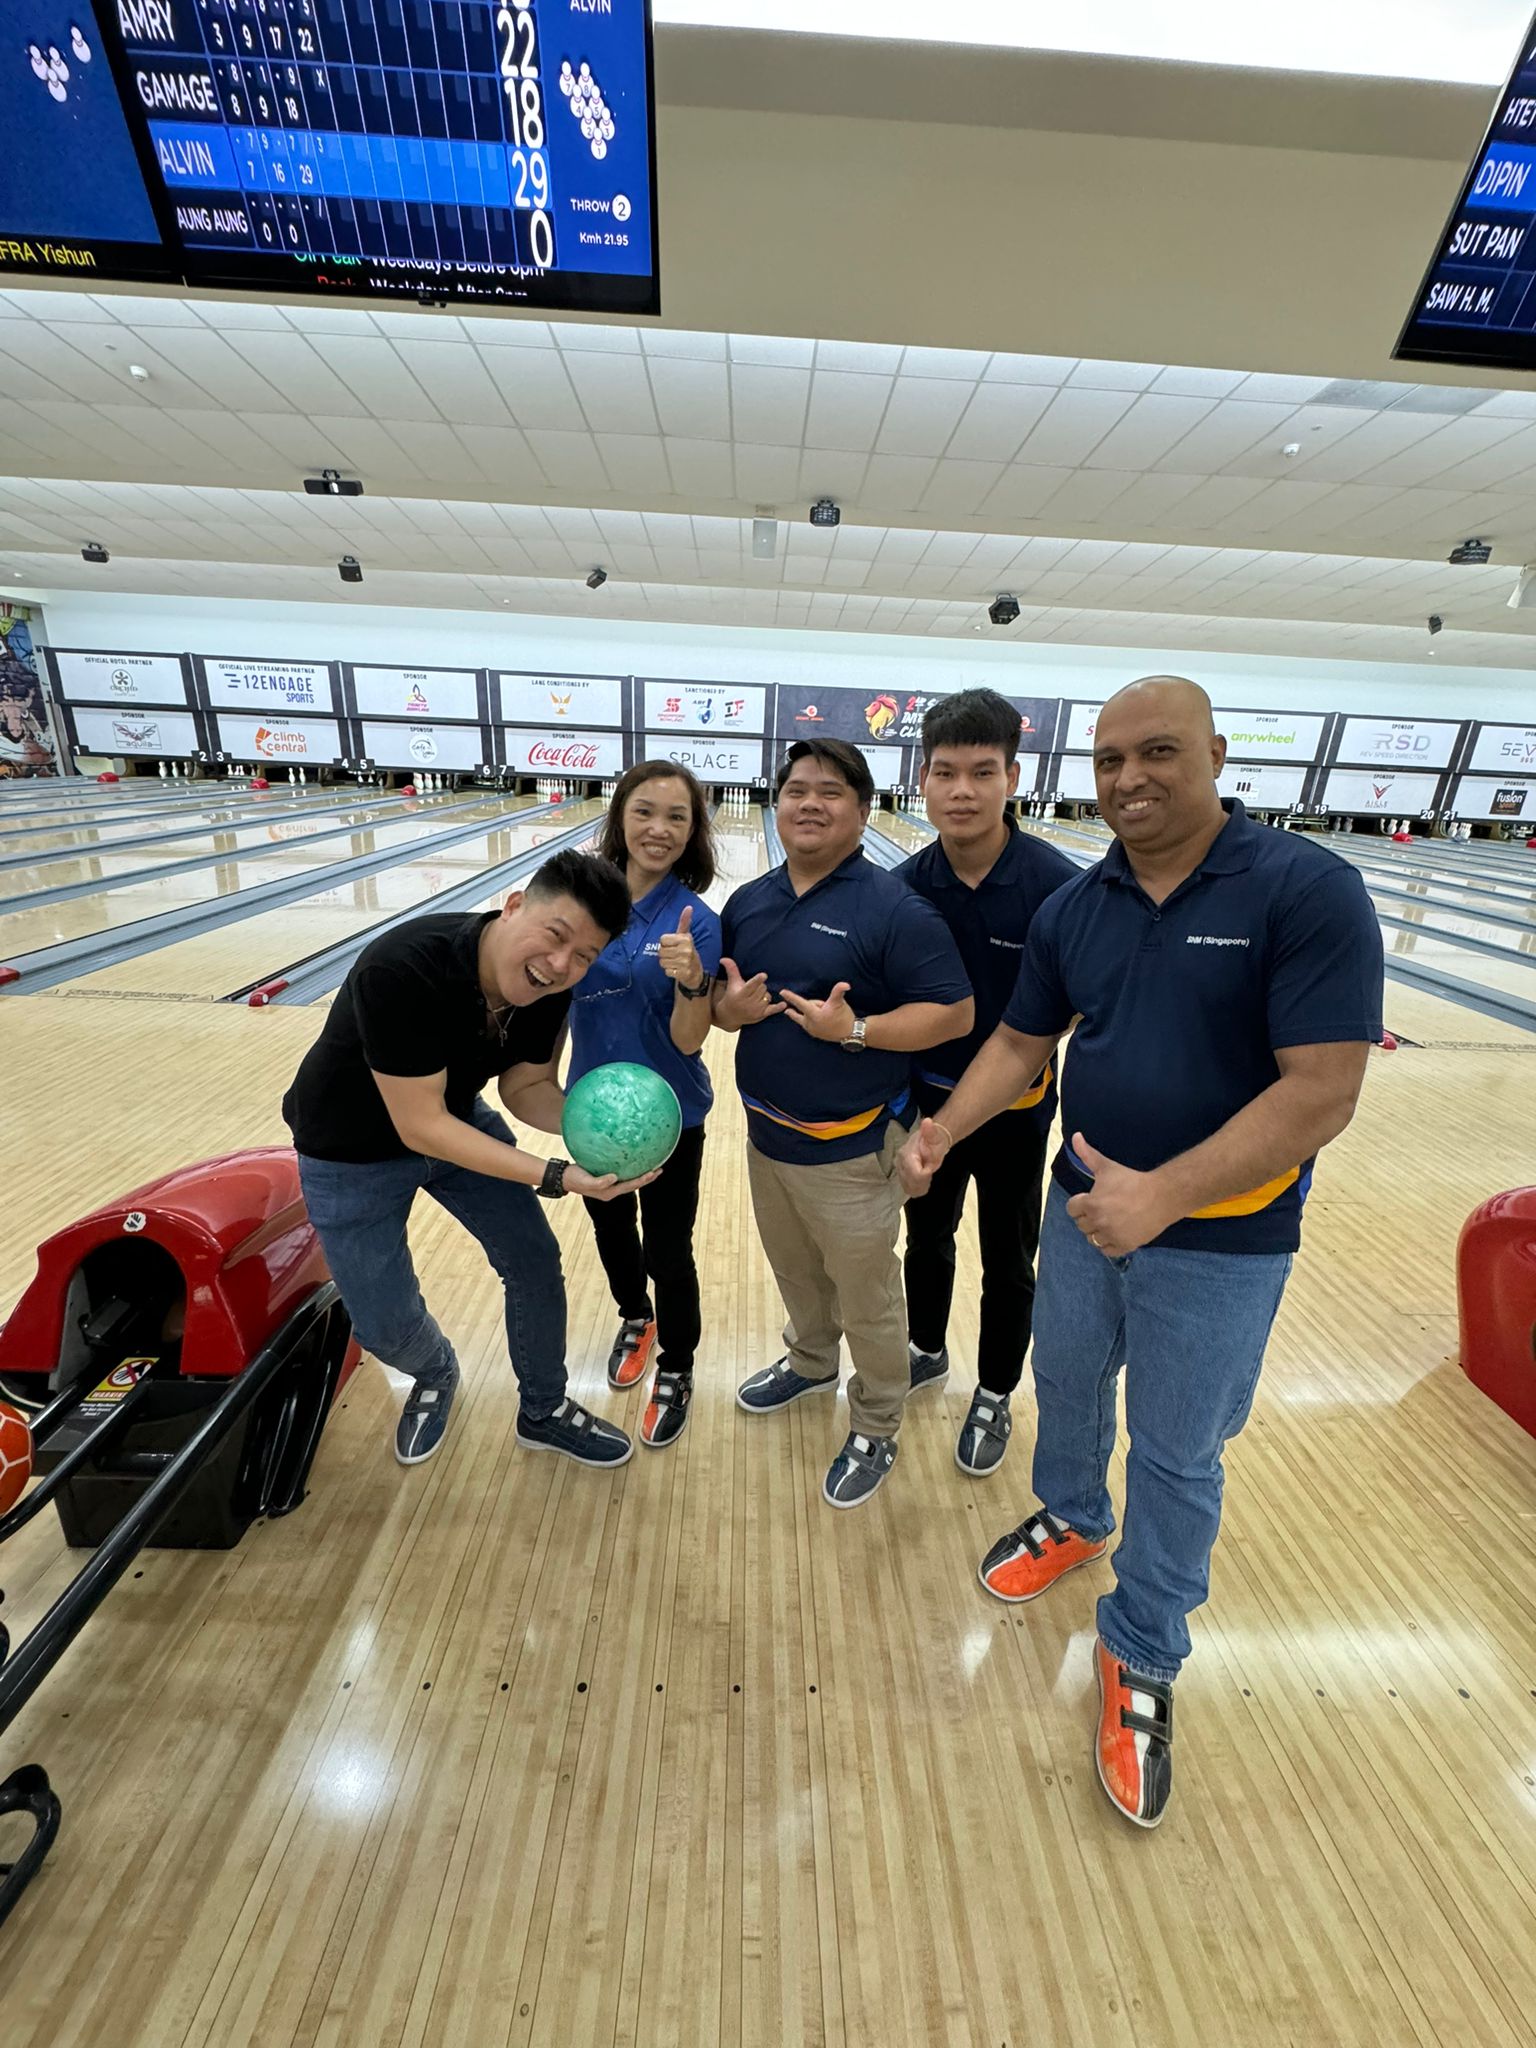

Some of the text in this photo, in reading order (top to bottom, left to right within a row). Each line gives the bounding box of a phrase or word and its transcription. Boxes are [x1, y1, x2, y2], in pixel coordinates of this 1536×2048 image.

[117, 0, 175, 41] AMRY
[212, 22, 314, 52] 3 9 17 22
[497, 10, 538, 78] 22
[137, 70, 218, 111] GAMAGE
[231, 94, 298, 120] 8 9 18
[504, 77, 544, 150] 18
[160, 138, 216, 176] ALVIN
[272, 162, 286, 182] 16
[300, 164, 313, 185] 29
[512, 150, 548, 209] 29
[1474, 159, 1532, 198] DIPIN
[570, 199, 610, 214] THROW
[176, 206, 248, 234] AUNG AUNG
[262, 222, 298, 244] 0 0
[530, 209, 553, 268] 0
[580, 232, 628, 247] Kmh 21.95
[1450, 222, 1525, 260] SUT PAN
[0, 241, 97, 267] FRA Yishun
[1426, 282, 1496, 314] SAW H. M.
[243, 674, 313, 692] 12ENGAGE
[286, 692, 314, 704] SPORTS
[273, 732, 306, 742] climb
[1230, 731, 1296, 744] anywheel
[1371, 733, 1432, 752] RSD
[266, 742, 307, 753] central
[199, 752, 208, 762] 2
[216, 752, 224, 762] 3
[342, 758, 349, 768] 4
[360, 760, 367, 770] 5
[482, 765, 490, 775] 6
[500, 766, 507, 775] 7
[754, 778, 768, 788] 10
[892, 786, 904, 794] 12
[1026, 792, 1039, 802] 14
[1050, 792, 1063, 802] 15
[1496, 790, 1522, 804] fusion
[1292, 803, 1304, 814] 18
[1314, 804, 1328, 815] 19
[1420, 810, 1434, 820] 20
[1442, 810, 1457, 821] 21
[1202, 936, 1250, 948] (Singapore)
